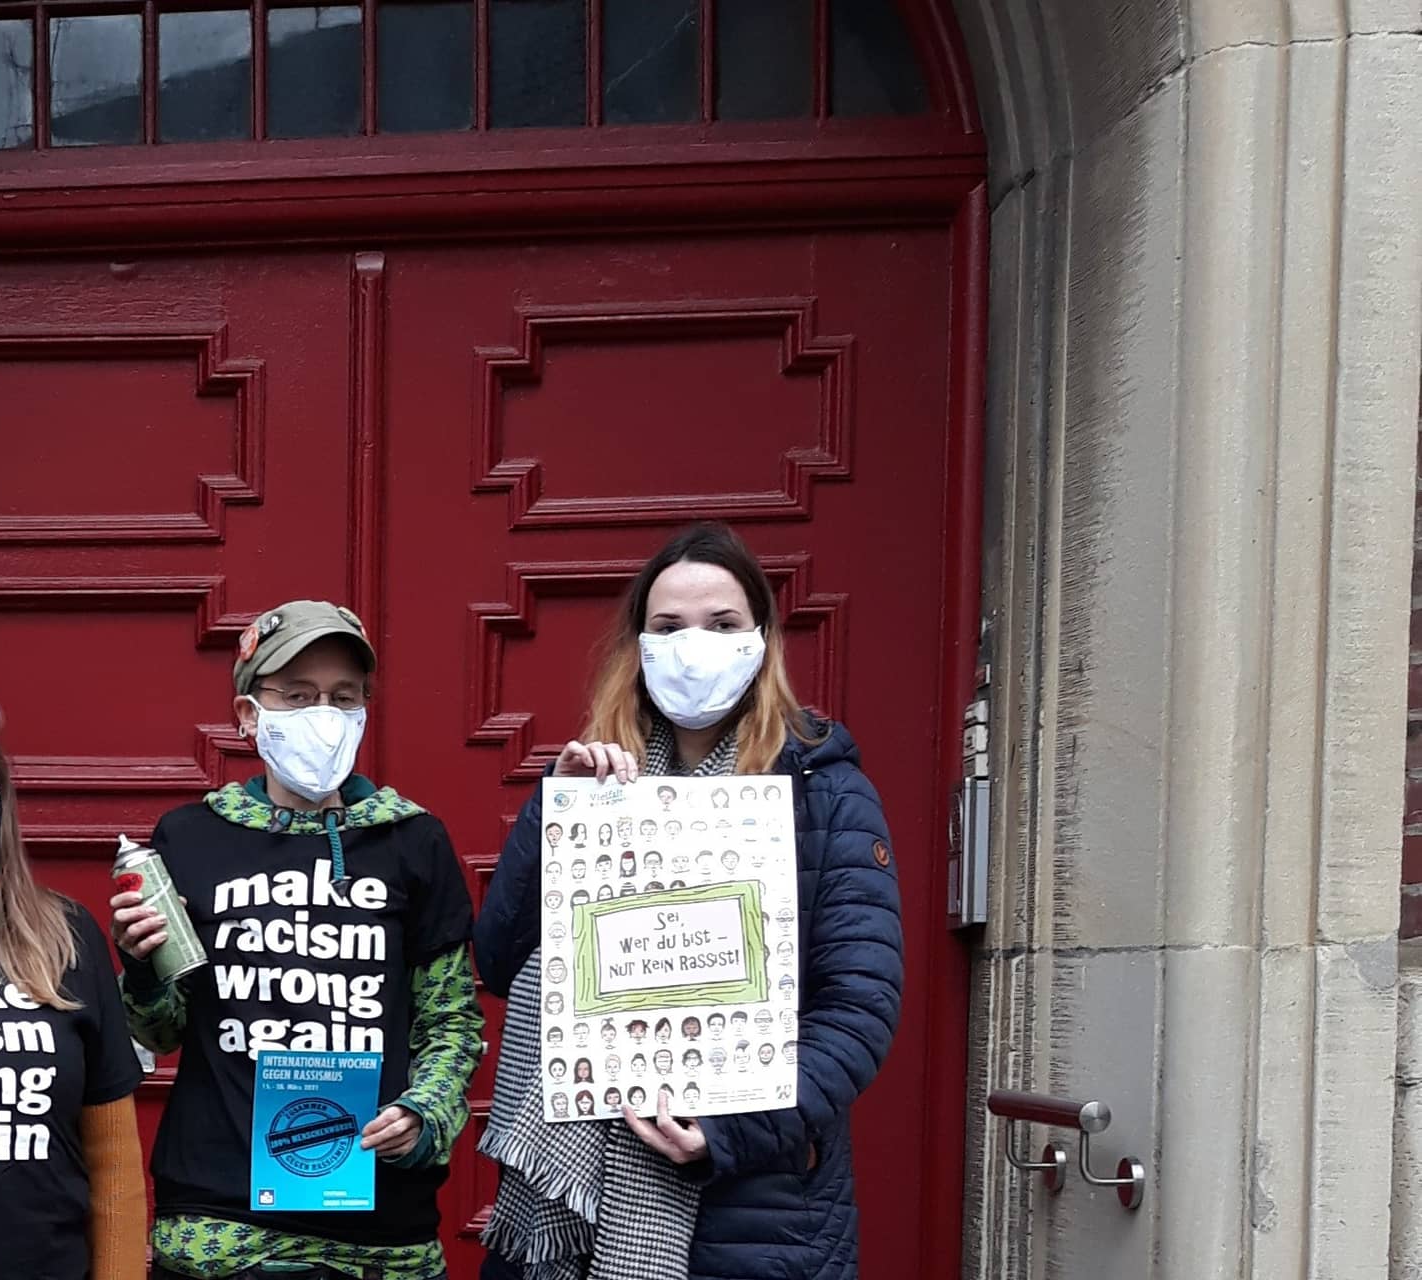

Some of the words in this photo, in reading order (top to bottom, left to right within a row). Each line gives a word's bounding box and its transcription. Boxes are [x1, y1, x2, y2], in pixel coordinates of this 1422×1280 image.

[214, 858, 388, 914] make
[214, 910, 386, 961] racism
[214, 965, 385, 1019] wrong
[218, 1010, 385, 1062] again
[262, 1069, 291, 1080] GEGEN
[293, 1070, 343, 1082] RASSISMUS
[263, 1055, 336, 1069] INTERNATIONALE
[338, 1058, 378, 1070] WOCHEN
